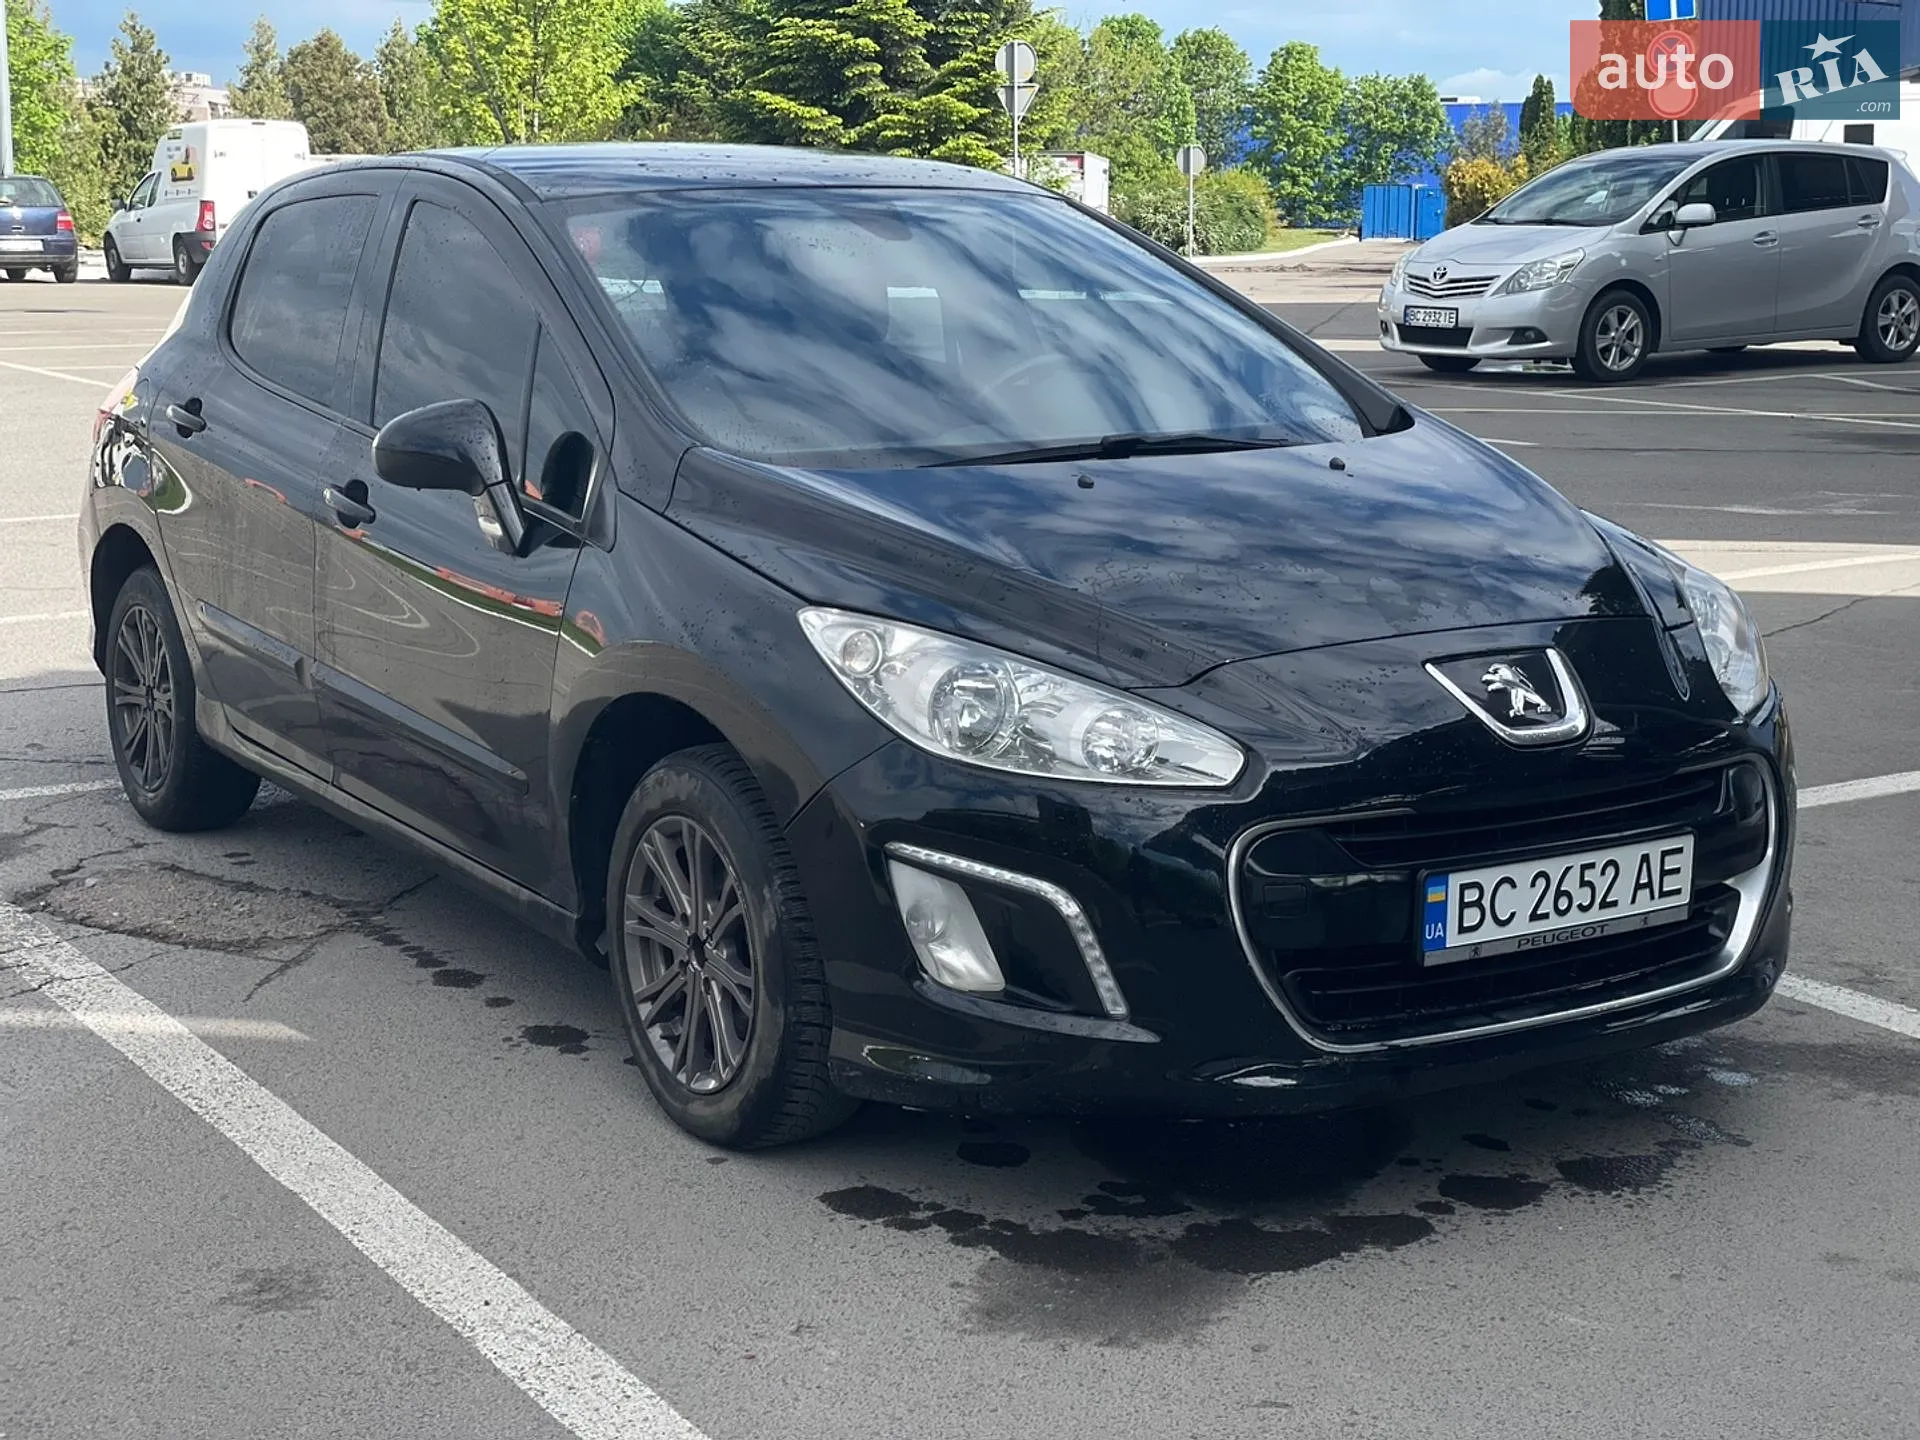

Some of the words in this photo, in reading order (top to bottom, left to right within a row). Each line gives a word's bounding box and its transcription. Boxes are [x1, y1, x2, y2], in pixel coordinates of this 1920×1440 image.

[1409, 310, 1421, 321] BC
[1457, 876, 1518, 935] BC
[1528, 858, 1620, 923] 2652
[1630, 846, 1684, 905] AE
[1425, 923, 1444, 939] UA
[1516, 923, 1610, 949] PEUGEOT
